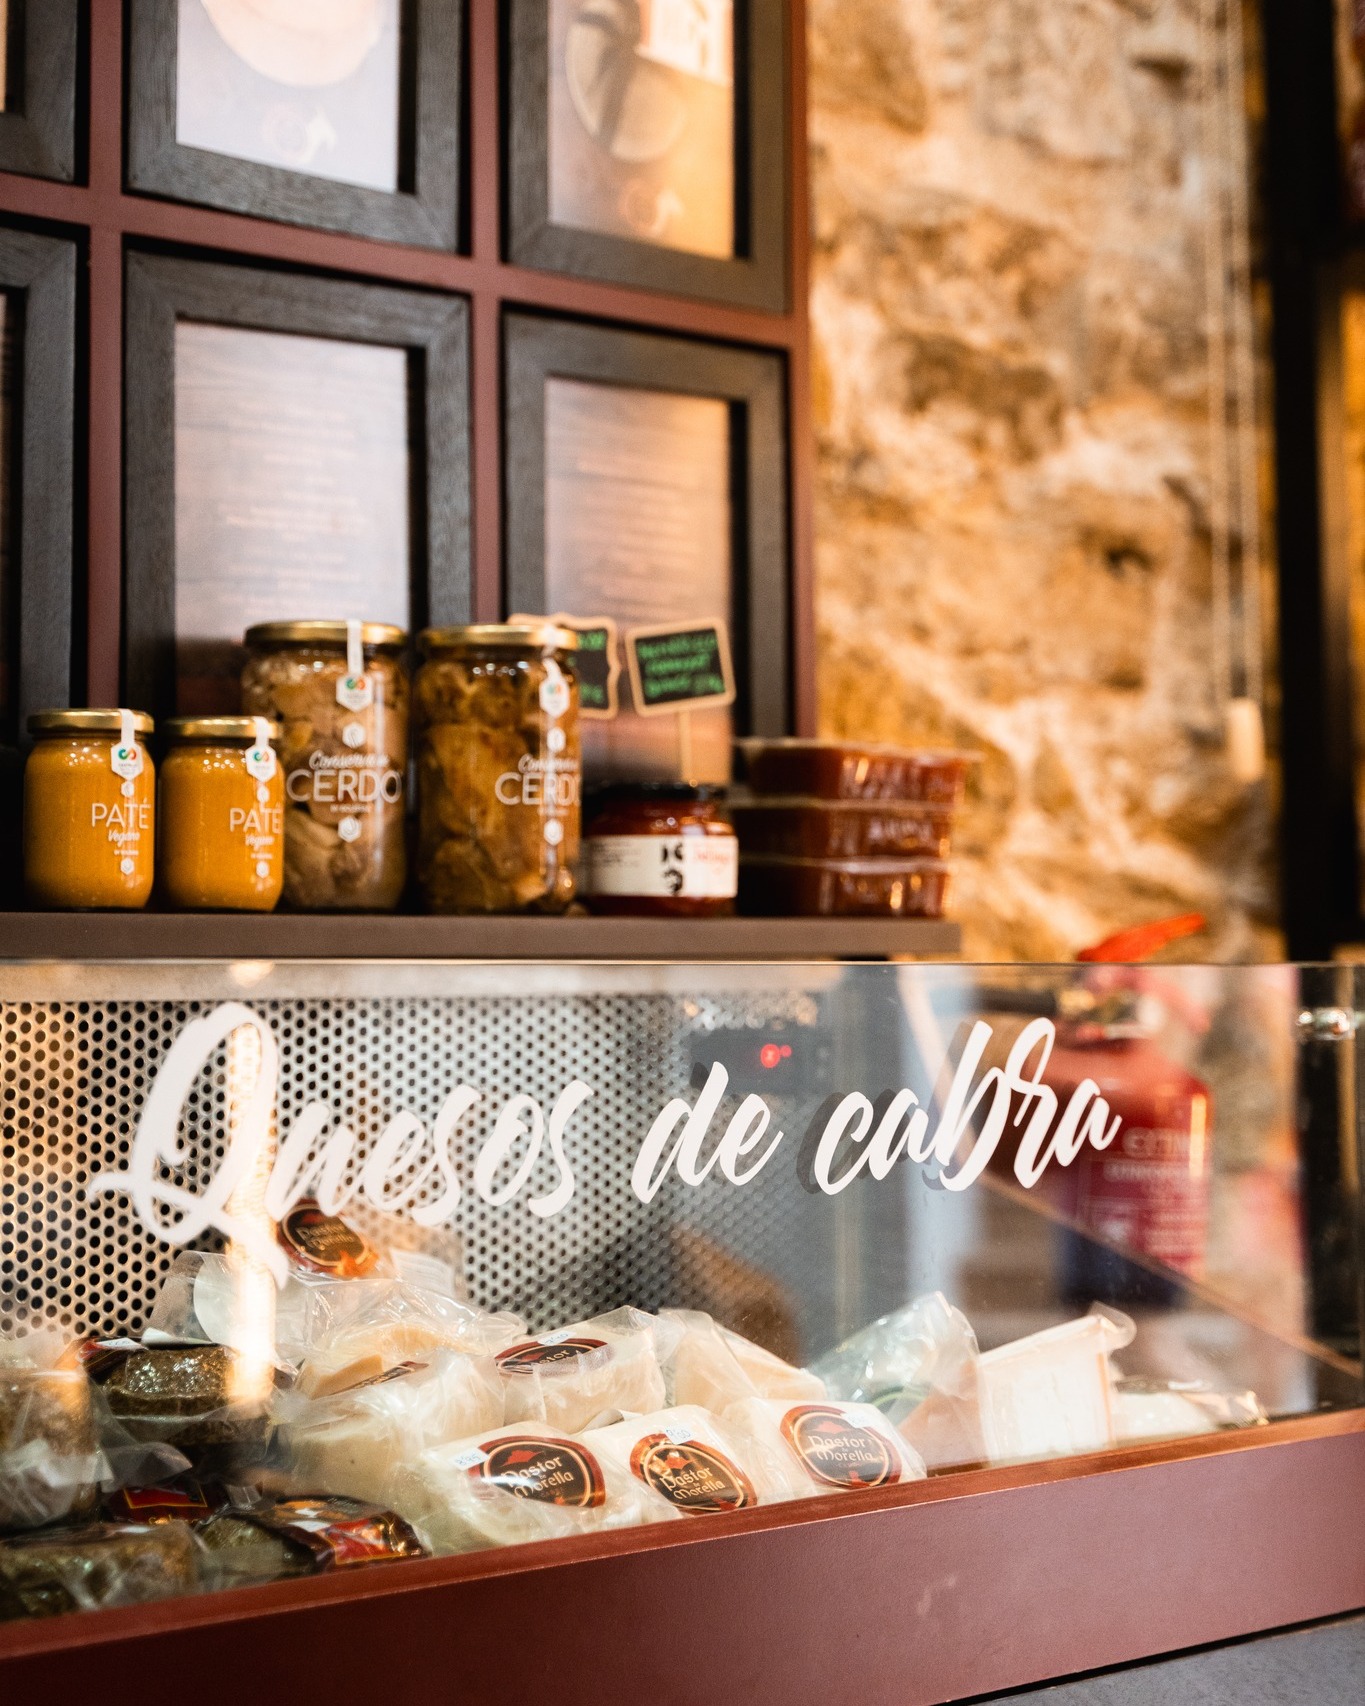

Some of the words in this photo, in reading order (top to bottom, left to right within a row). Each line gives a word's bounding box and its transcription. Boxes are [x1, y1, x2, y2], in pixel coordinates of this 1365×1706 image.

[286, 769, 401, 803] CERDO
[91, 797, 151, 829] PATÉ
[87, 1001, 594, 1290] Quesos
[631, 1061, 784, 1204] de
[814, 1017, 1122, 1195] cabra
[539, 1349, 570, 1364] stor
[808, 1435, 866, 1450] Pastor
[501, 1456, 562, 1487] Pastor
[514, 1470, 574, 1501] Morella
[659, 1466, 714, 1492] Pastor
[673, 1479, 726, 1500] Morella
